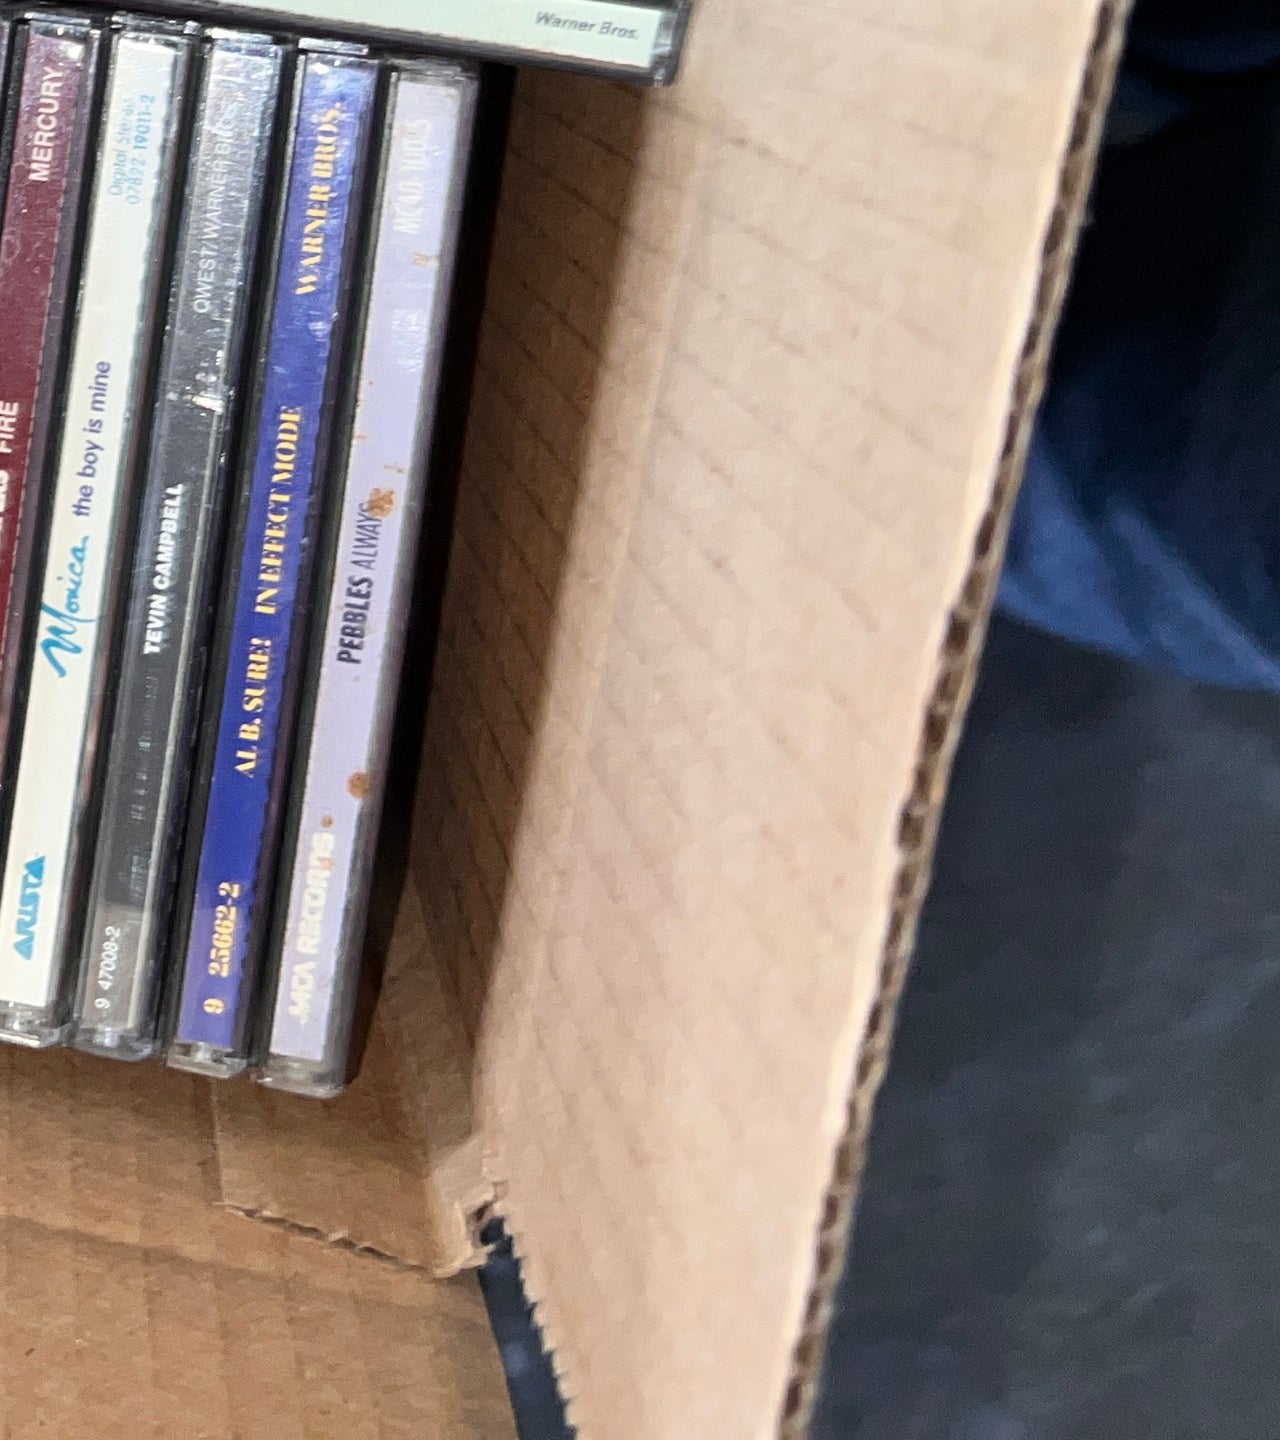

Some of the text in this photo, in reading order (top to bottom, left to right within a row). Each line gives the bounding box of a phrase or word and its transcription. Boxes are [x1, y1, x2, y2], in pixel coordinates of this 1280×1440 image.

[535, 10, 639, 40] Warner Bros.
[27, 65, 65, 183] MERCURY
[295, 100, 342, 296] WARNER BROS.
[39, 360, 111, 677] Monica the boy is mine
[143, 481, 184, 657] TEVIN CAMPBELL
[231, 405, 301, 778] AL SURE! IN EFFECT MODE
[336, 575, 373, 664] PEBBLES
